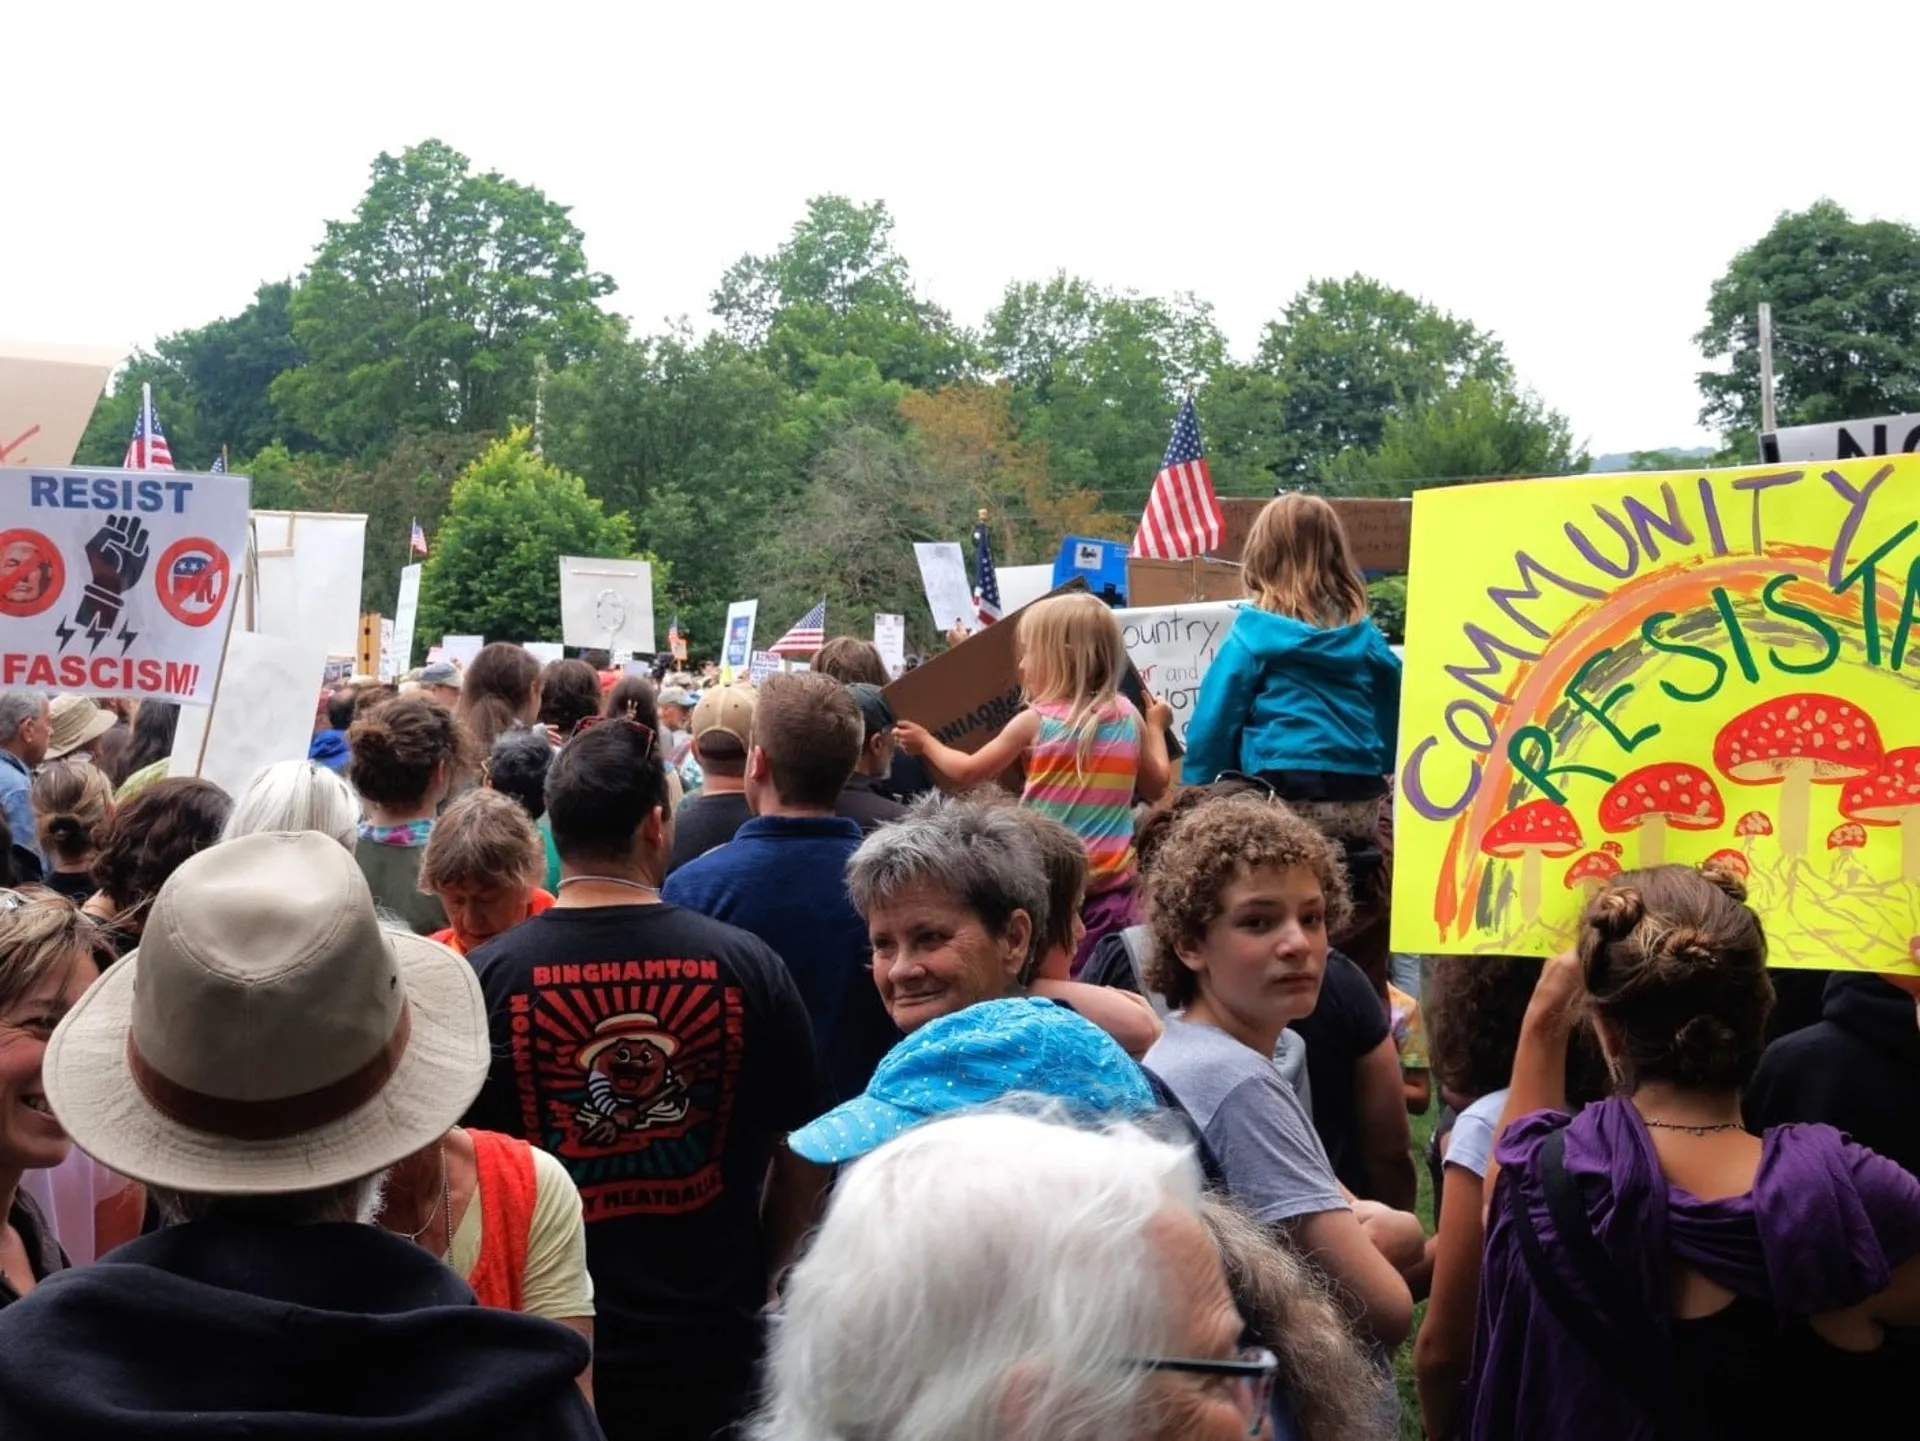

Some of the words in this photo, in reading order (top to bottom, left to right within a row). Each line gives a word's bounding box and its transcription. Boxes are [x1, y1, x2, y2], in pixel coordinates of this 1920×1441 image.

[30, 475, 193, 515] RESIST
[1122, 610, 1220, 657] ountry
[1402, 463, 1895, 821] COMMUNITY
[3, 652, 200, 697] FASCISM!
[1166, 655, 1198, 682] and
[533, 959, 718, 986] BINGHAMTON
